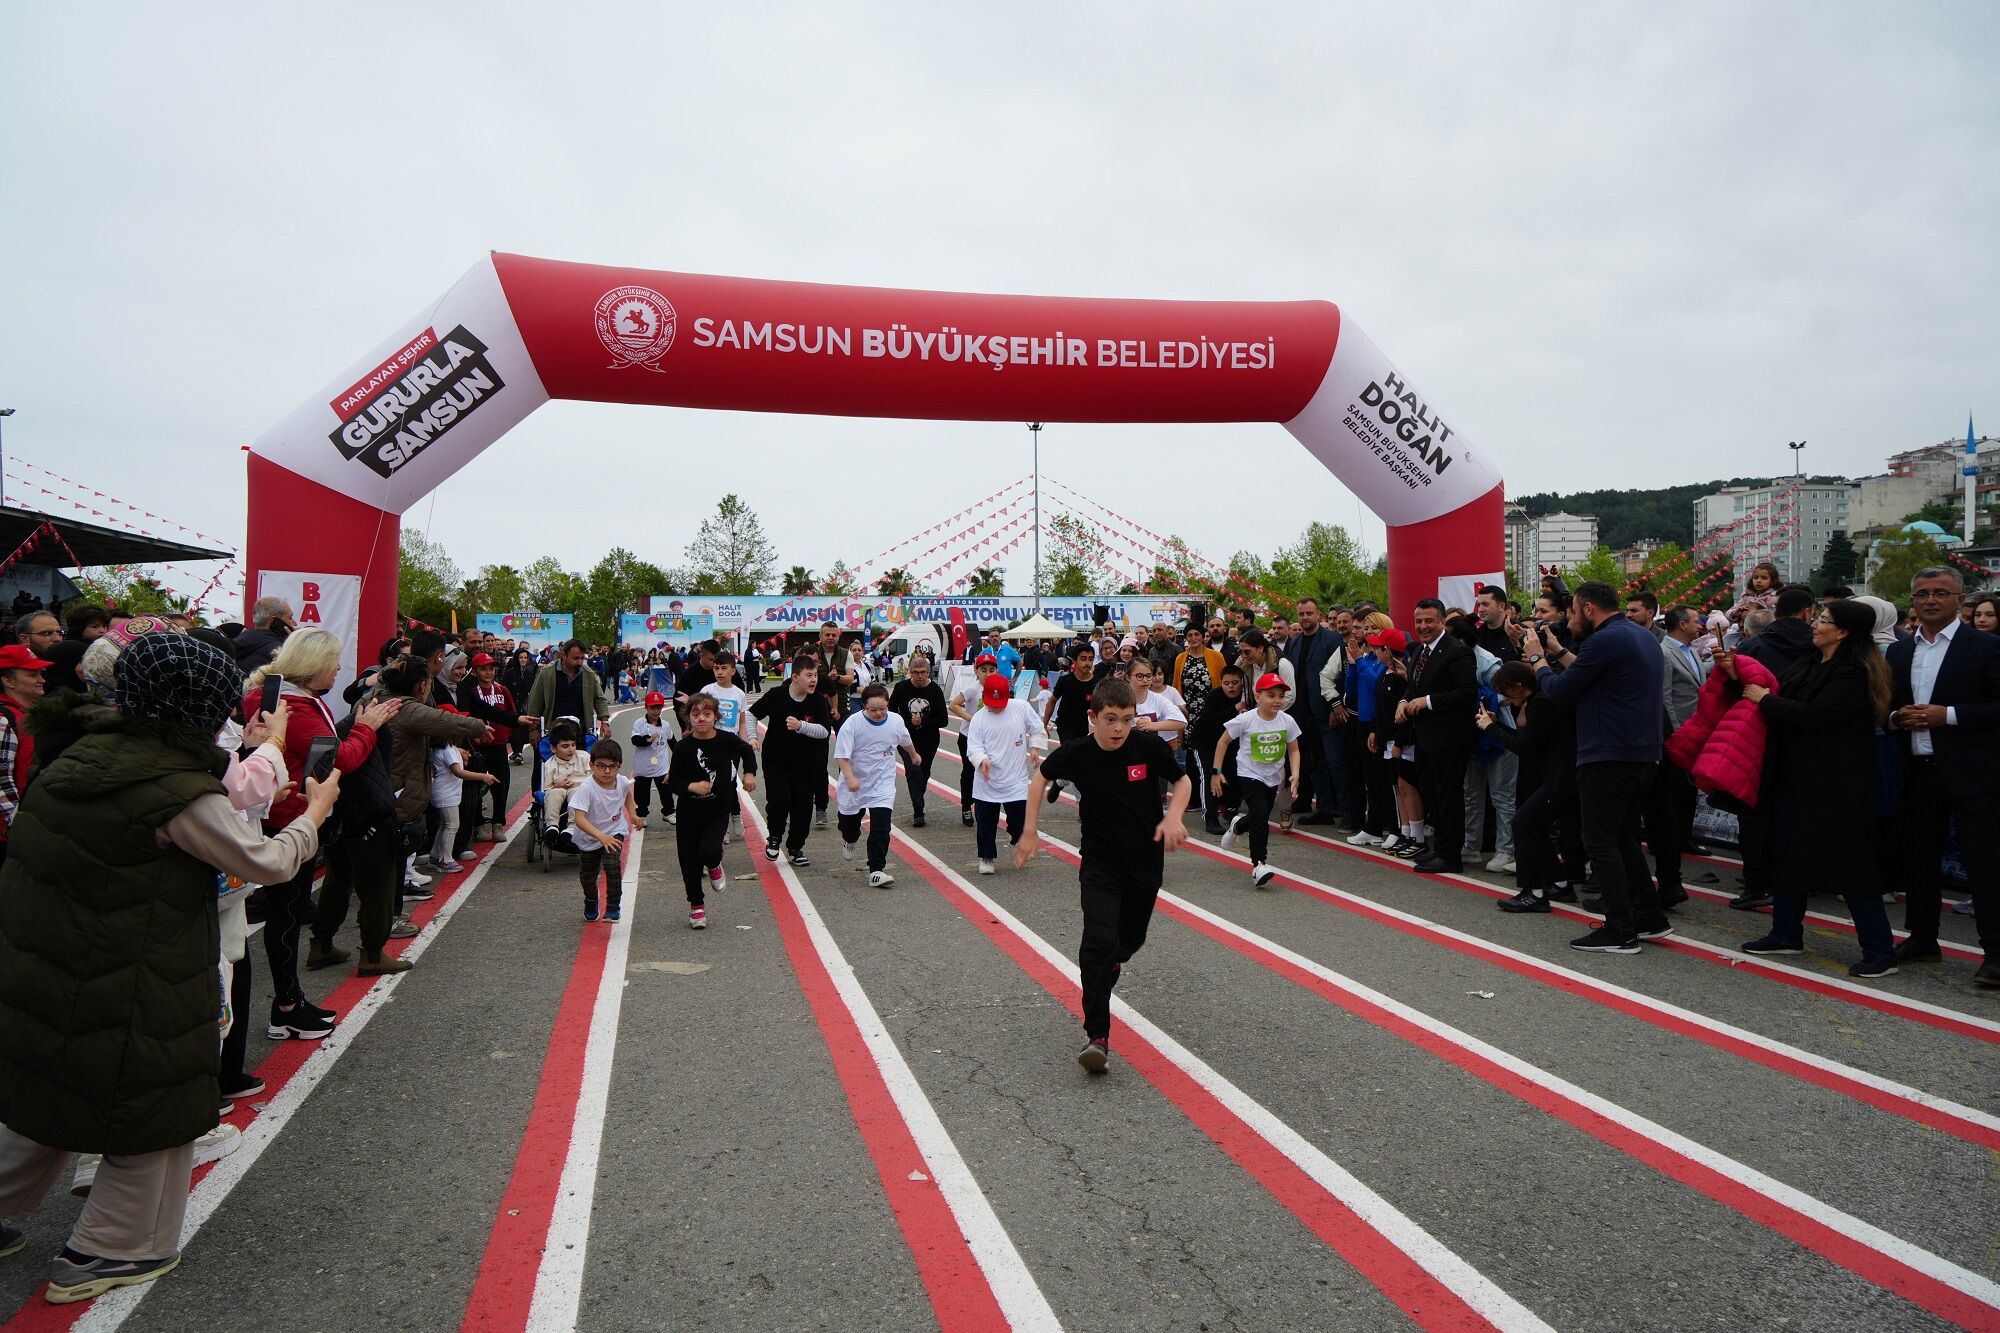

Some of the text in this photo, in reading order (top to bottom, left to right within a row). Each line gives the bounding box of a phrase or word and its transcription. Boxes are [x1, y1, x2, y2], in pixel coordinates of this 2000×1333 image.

[340, 335, 432, 411] PARLAYAN ŞEHİR
[693, 317, 1274, 372] SAMSUN BÜYÜKŞEHİR BELEDİYESİ
[342, 340, 475, 448] GURURLA
[377, 366, 495, 469] SAMSUN
[1359, 380, 1453, 475] DOĞAN
[1384, 371, 1455, 443] HALİT
[1342, 416, 1419, 490] BELEDİYE BAŞKANI
[1346, 404, 1432, 487] SAMSUN BÜYÜKŞEHİR
[502, 615, 551, 632] ÇOCUK
[646, 617, 693, 633] ÇOCUK
[766, 607, 844, 621] SAMSUN
[845, 604, 918, 629] ÇOCUK
[917, 607, 1018, 621] MAATONU
[1043, 603, 1125, 621] FESTİLİ
[1259, 744, 1279, 754] 1621
